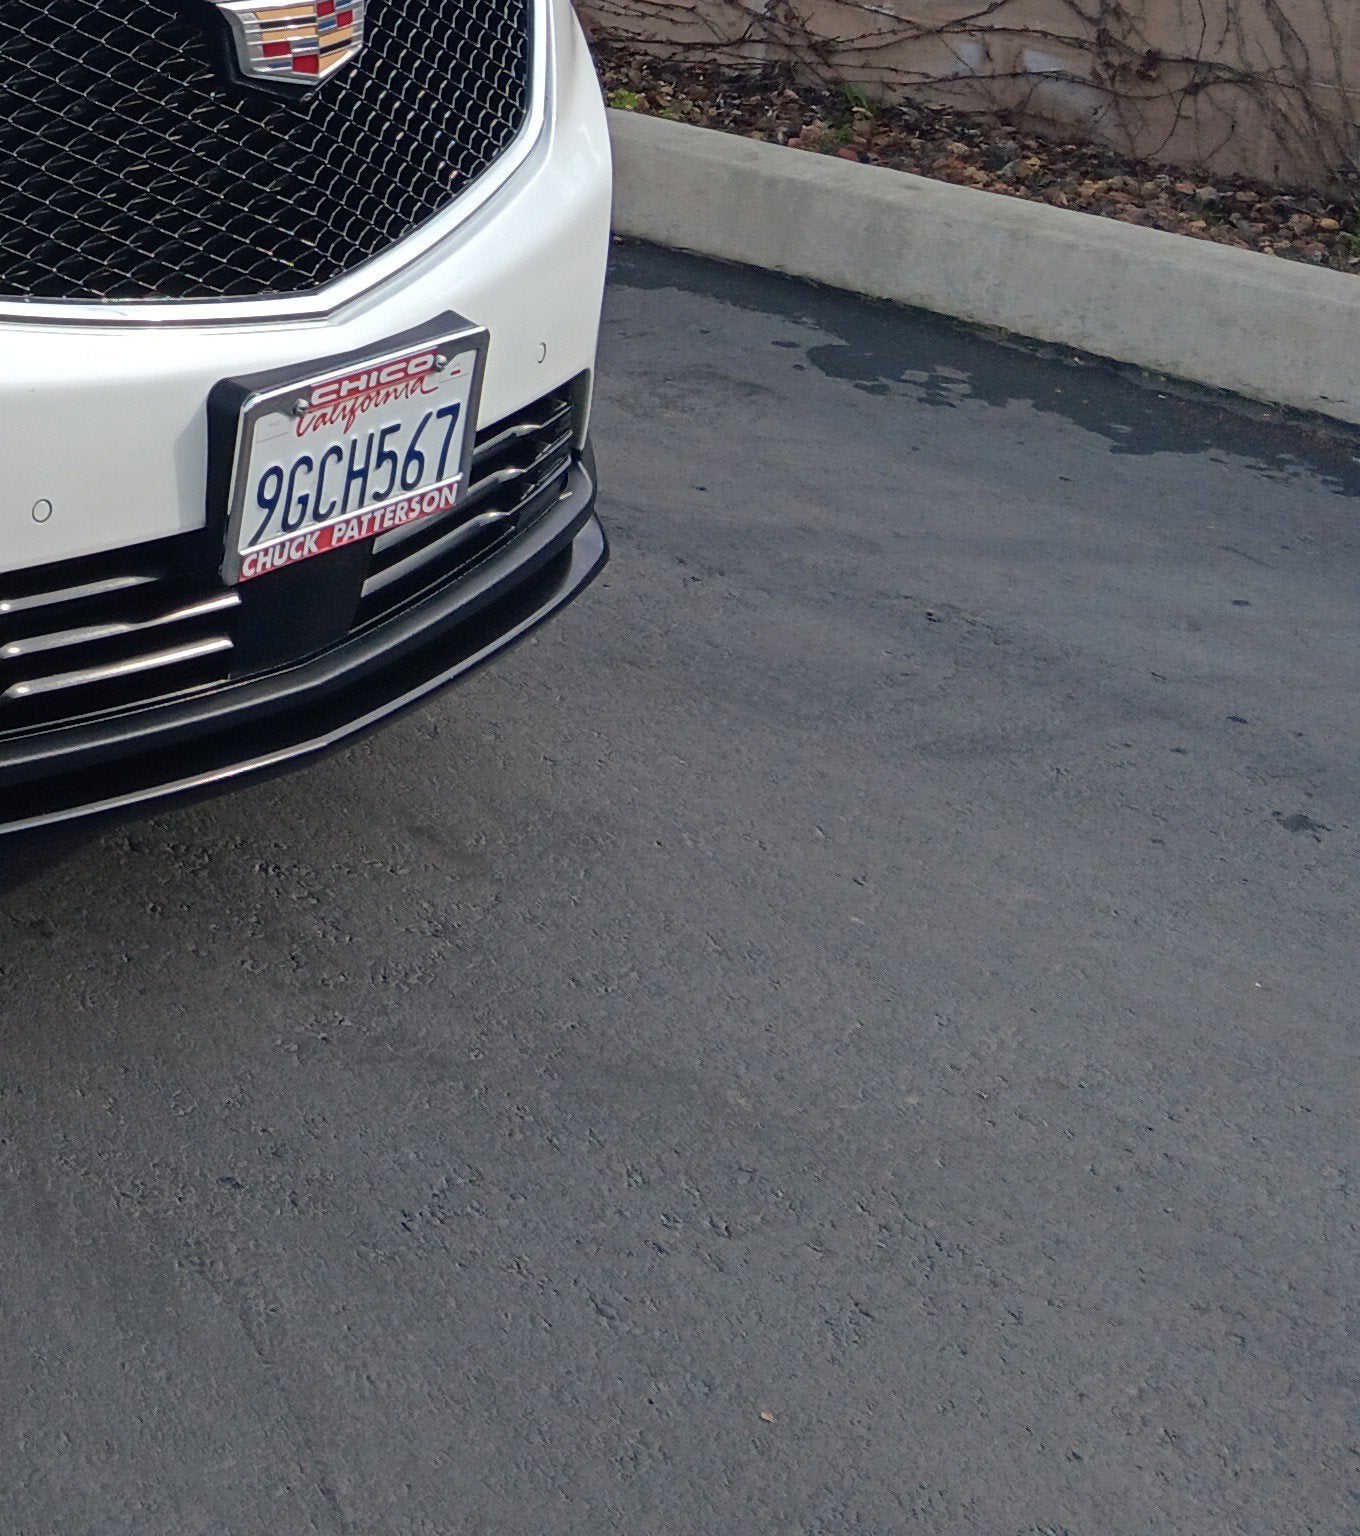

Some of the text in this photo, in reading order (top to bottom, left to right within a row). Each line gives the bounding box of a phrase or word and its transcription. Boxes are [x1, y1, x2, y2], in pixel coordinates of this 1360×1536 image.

[296, 375, 439, 438] California
[311, 353, 434, 406] CHICO
[248, 402, 461, 547] 9GCH567
[241, 485, 459, 578] CHUCK PATTERSON
